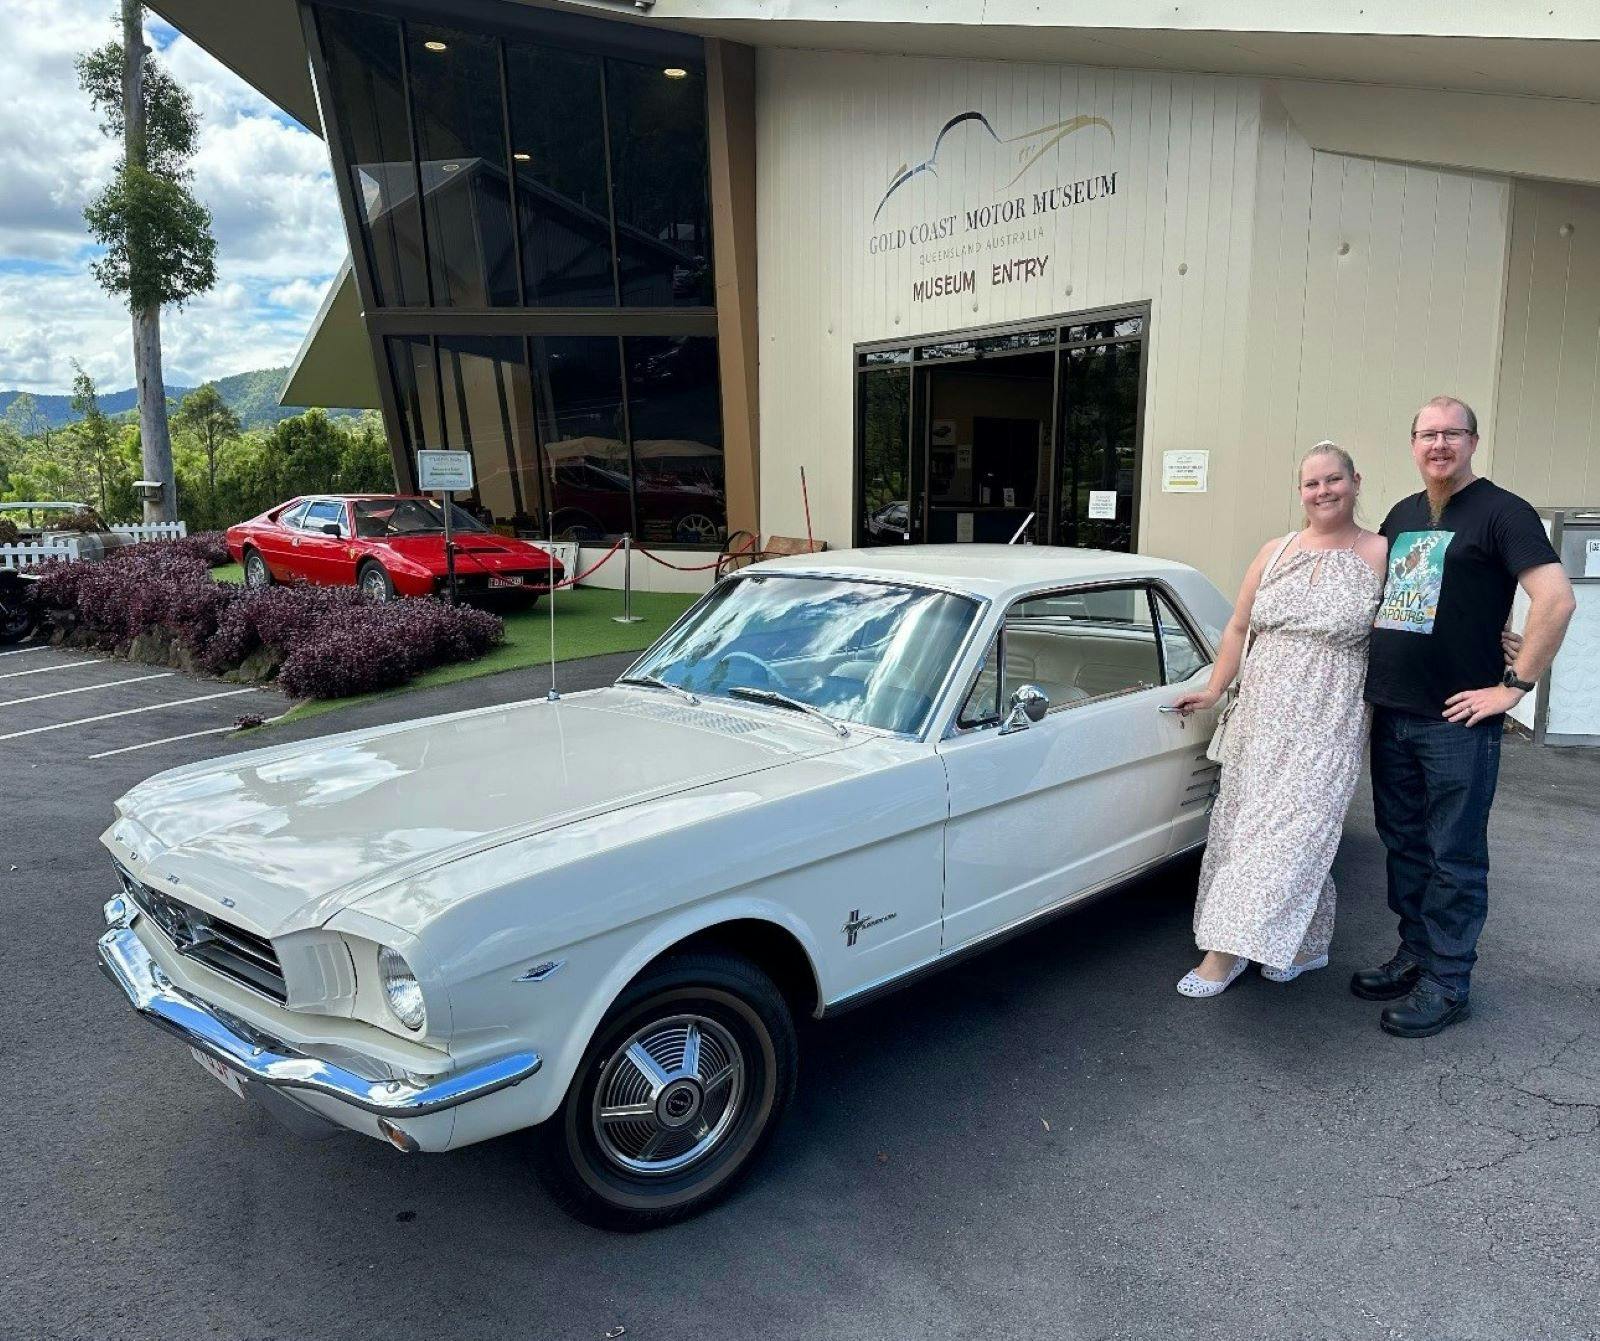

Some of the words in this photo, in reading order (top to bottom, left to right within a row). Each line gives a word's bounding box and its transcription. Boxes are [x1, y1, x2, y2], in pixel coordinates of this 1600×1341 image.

[869, 229, 906, 254] GOLD
[909, 216, 957, 245] COAST
[965, 198, 1026, 232] MOTOR
[1032, 171, 1119, 215] MUSEUM
[919, 242, 982, 265] QUEENSLAND
[986, 226, 1044, 250] AUSTRALIA
[913, 269, 976, 303] MUSEUM
[992, 254, 1049, 285] ENTRY
